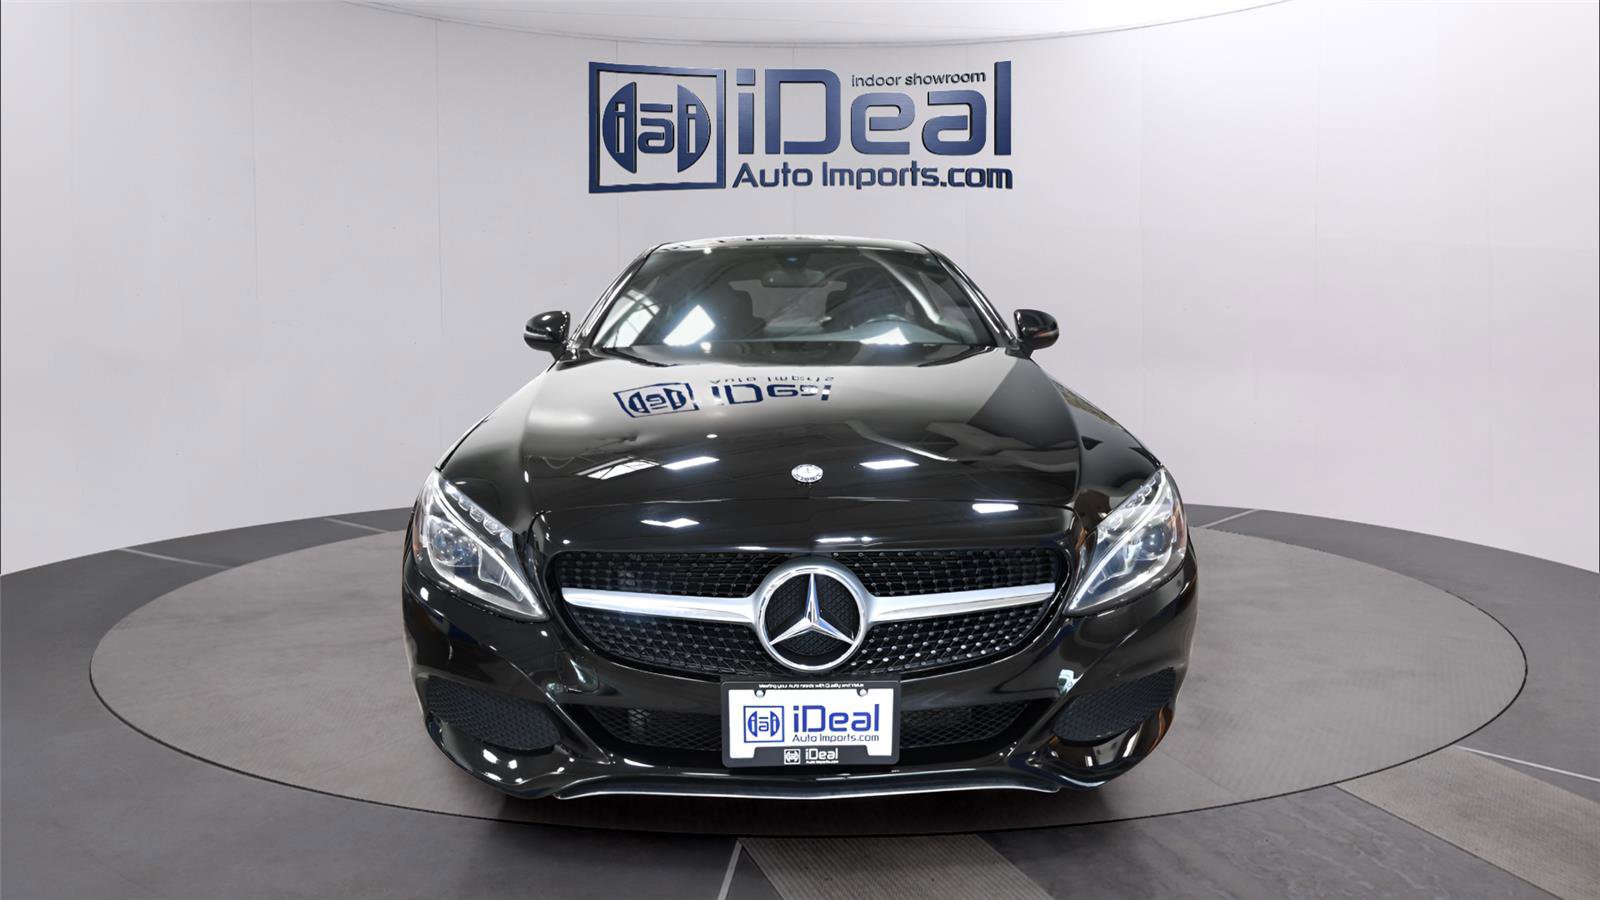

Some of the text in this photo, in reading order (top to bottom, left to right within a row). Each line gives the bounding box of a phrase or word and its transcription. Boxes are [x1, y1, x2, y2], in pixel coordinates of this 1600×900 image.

[852, 71, 987, 88] indoor showroom
[736, 60, 1012, 155] iDeal
[732, 161, 1013, 190] Auto Imports.com
[793, 704, 880, 733] iDeal
[792, 733, 880, 743] Auto Imports.com
[805, 748, 839, 760] iDeal
